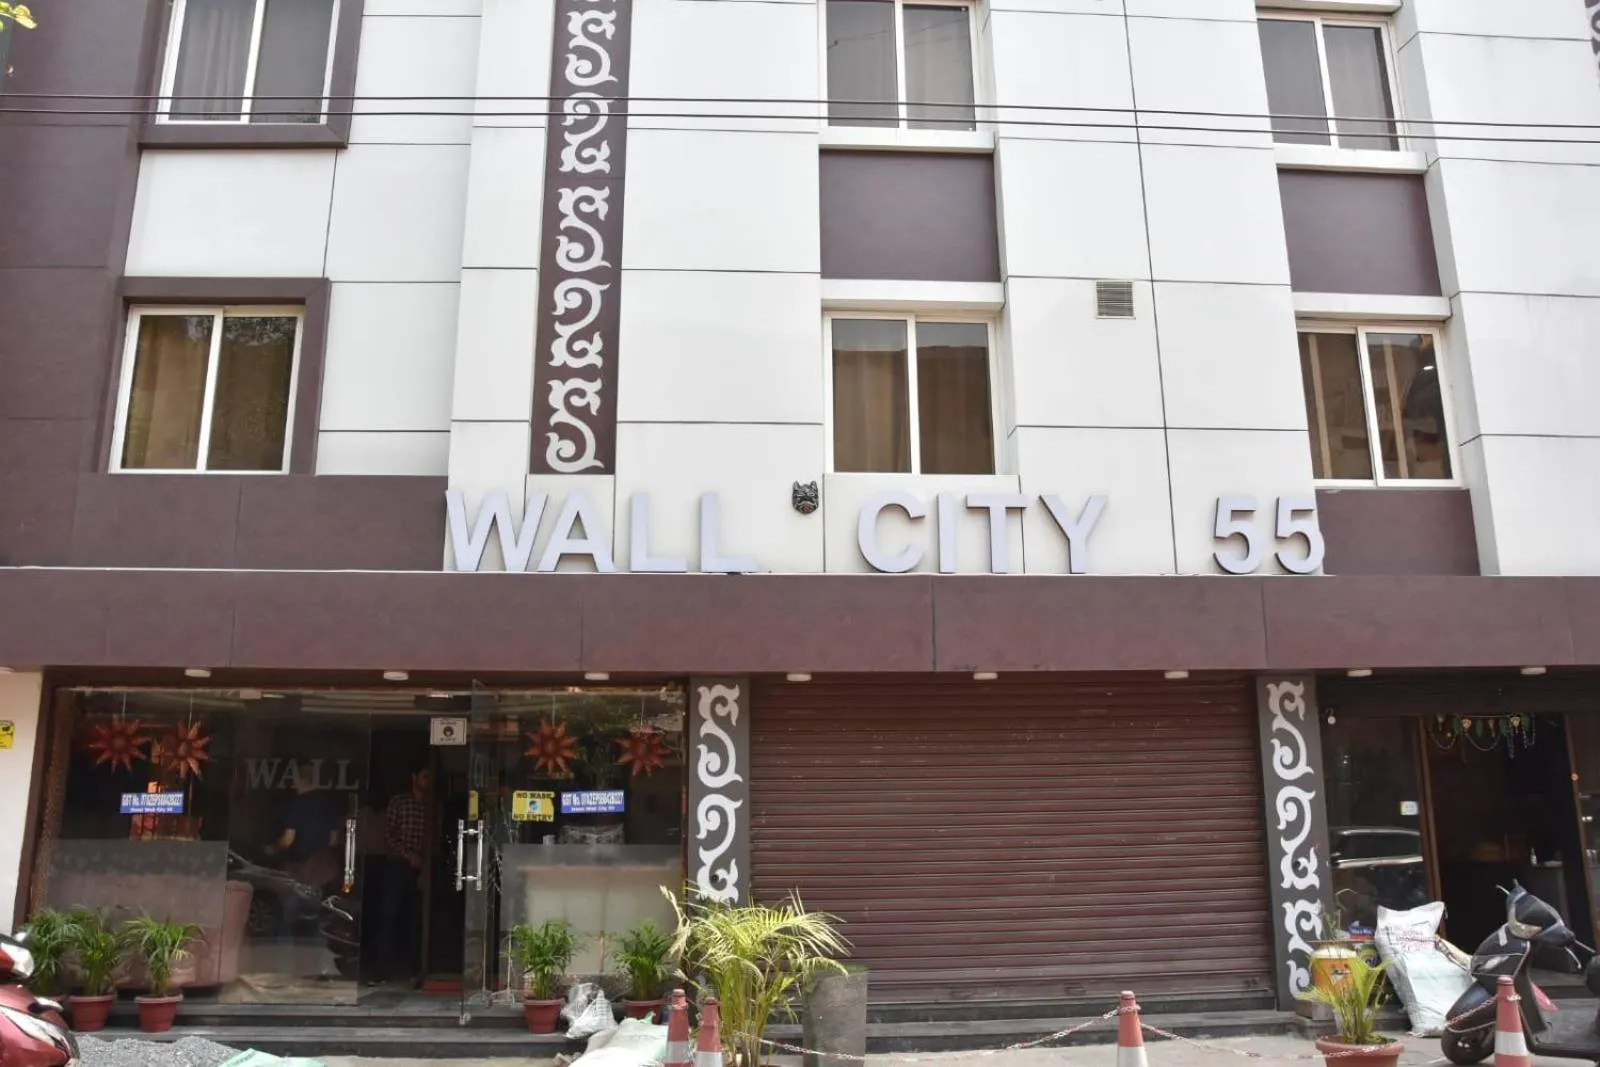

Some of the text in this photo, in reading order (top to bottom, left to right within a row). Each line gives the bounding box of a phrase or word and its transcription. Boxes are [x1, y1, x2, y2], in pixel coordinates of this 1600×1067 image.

[446, 489, 1325, 575] WALL CITY 55
[243, 758, 360, 790] WALL
